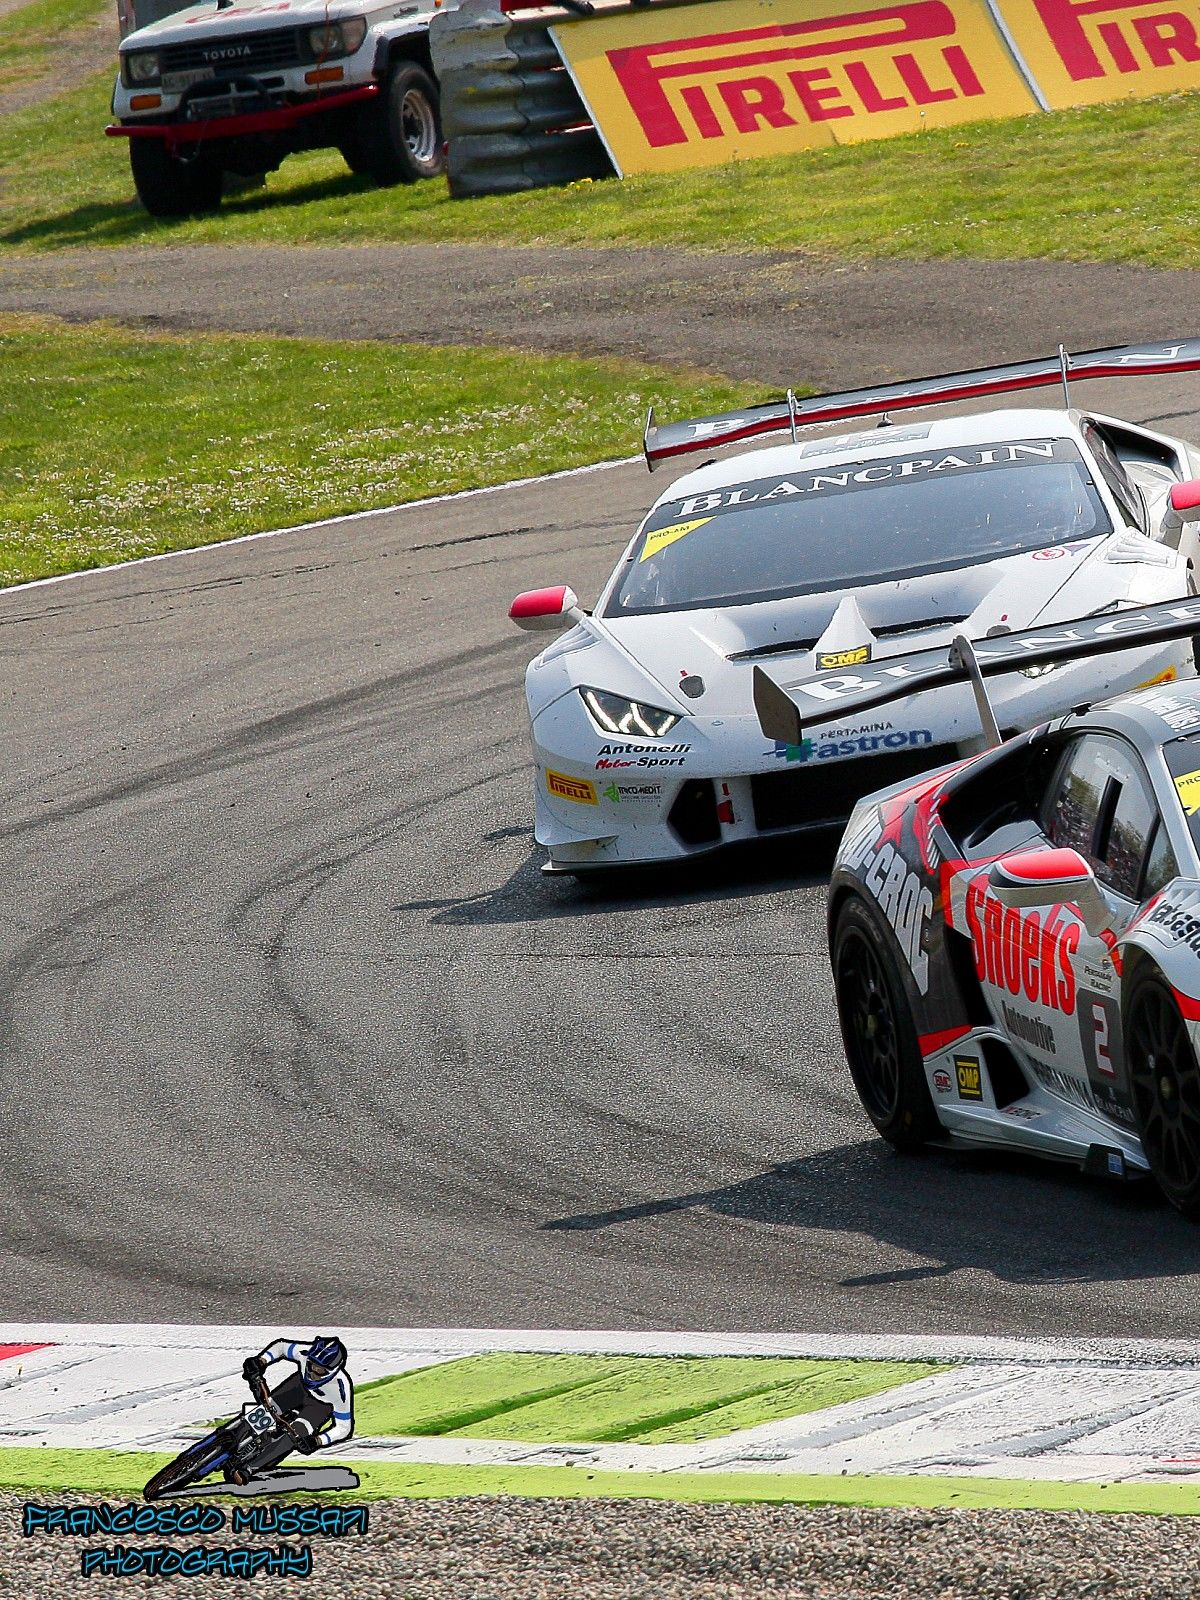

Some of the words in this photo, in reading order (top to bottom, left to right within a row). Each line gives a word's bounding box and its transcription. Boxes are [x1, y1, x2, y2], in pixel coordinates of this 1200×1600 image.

[203, 46, 251, 60] TOYOTA
[605, 0, 985, 148] PIRELLI
[673, 440, 1060, 518] BLANCPAIN
[650, 524, 691, 541] PRO-AM
[820, 648, 868, 666] OMP
[820, 721, 894, 740] PERTAMINA
[597, 743, 693, 756] Antonelli
[549, 773, 592, 800] PIRELLI
[1091, 1001, 1117, 1078] 2
[958, 1067, 980, 1089] OMP
